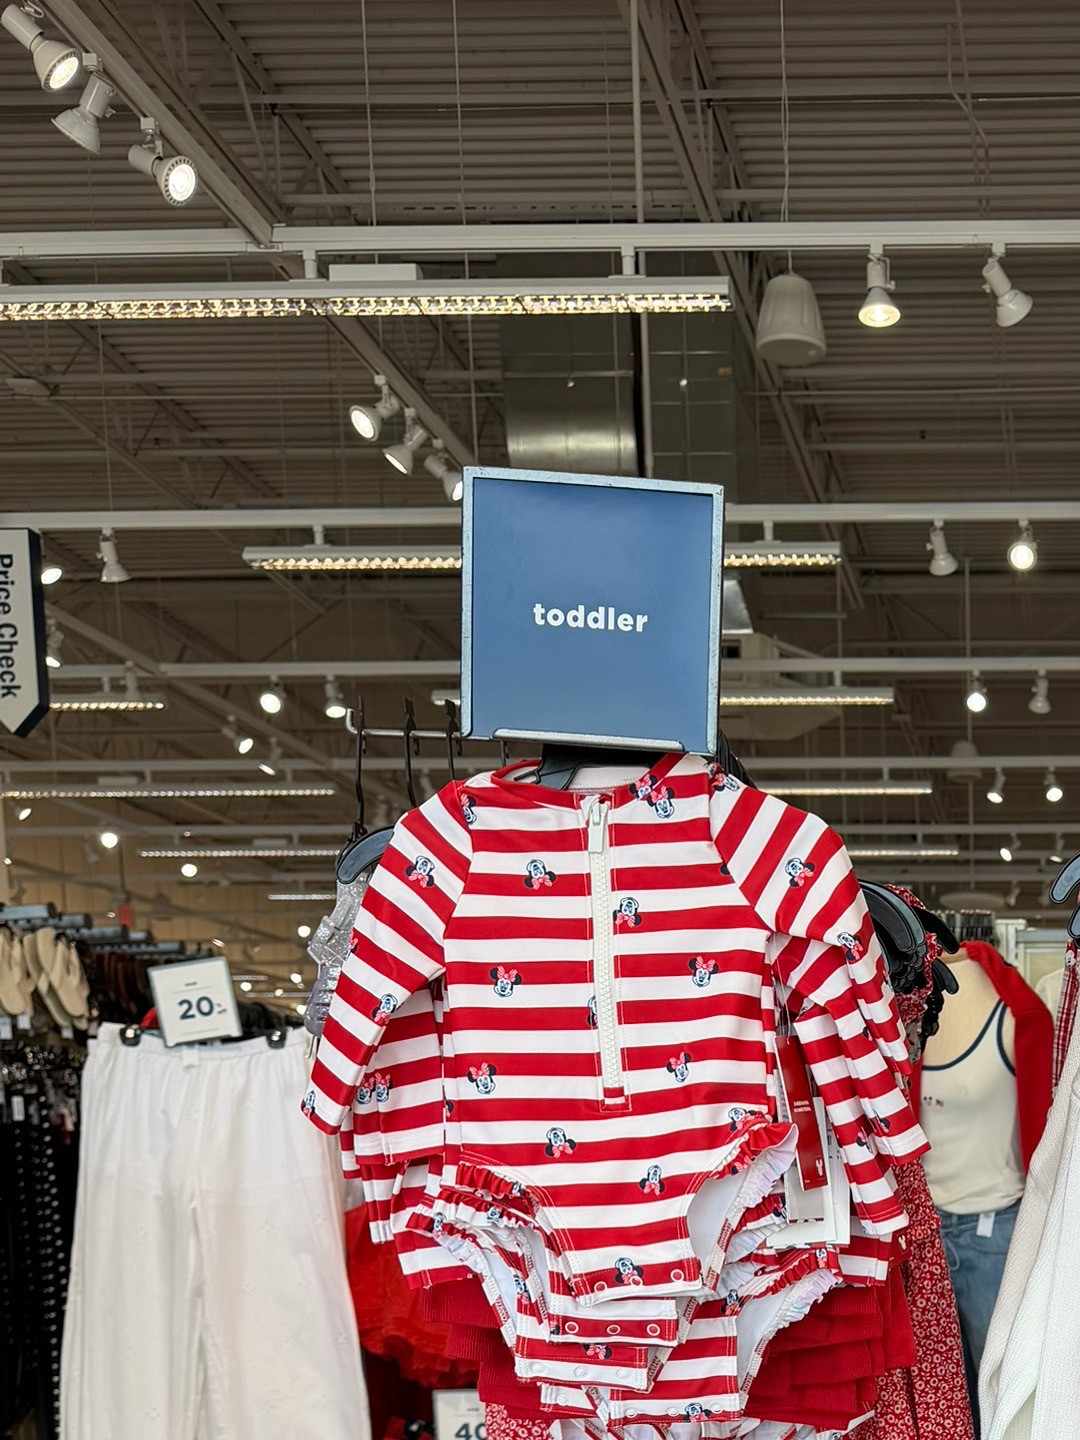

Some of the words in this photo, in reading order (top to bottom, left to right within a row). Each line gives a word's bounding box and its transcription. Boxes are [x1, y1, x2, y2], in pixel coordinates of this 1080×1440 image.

[0, 554, 14, 616] Price
[533, 603, 649, 634] toddler
[0, 623, 21, 698] Check
[178, 996, 214, 1020] 20
